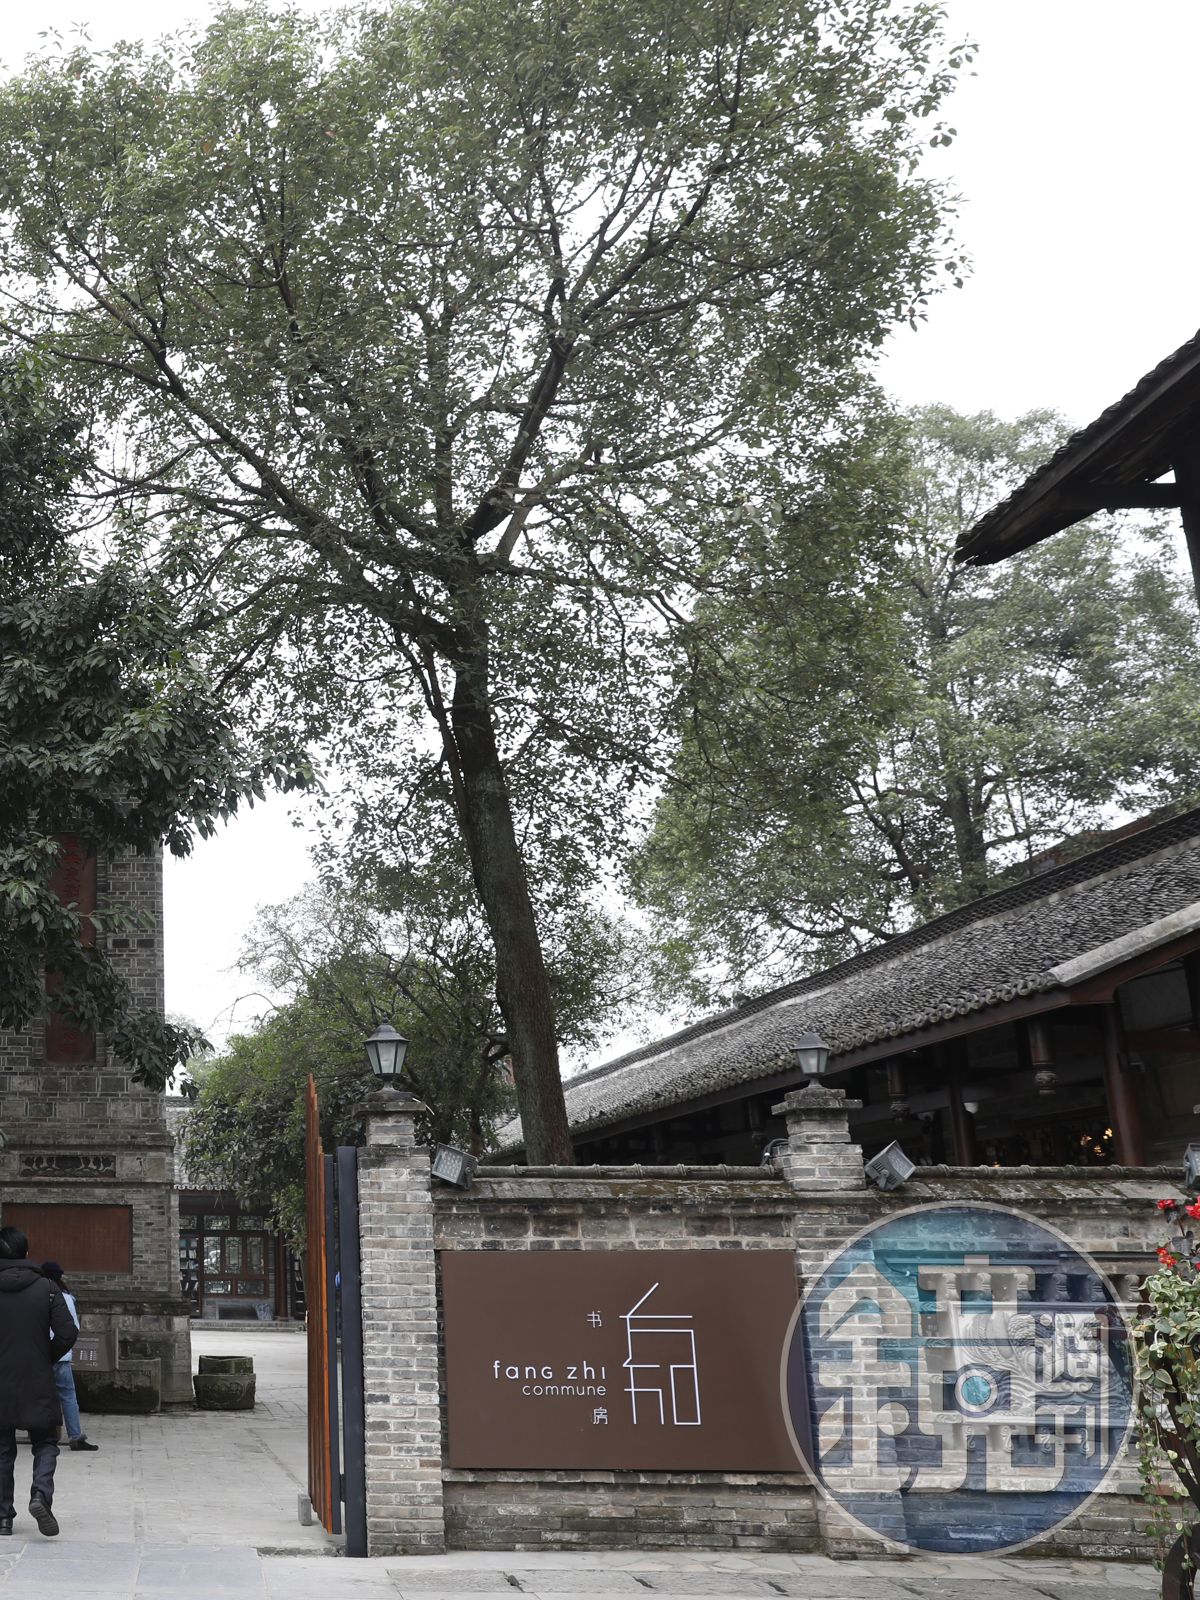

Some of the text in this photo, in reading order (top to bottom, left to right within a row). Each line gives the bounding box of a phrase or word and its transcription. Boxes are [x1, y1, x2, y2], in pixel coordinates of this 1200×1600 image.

[586, 1310, 603, 1328] 书
[566, 1360, 607, 1380] zhi
[522, 1384, 607, 1397] commune
[592, 1406, 609, 1426] 房
